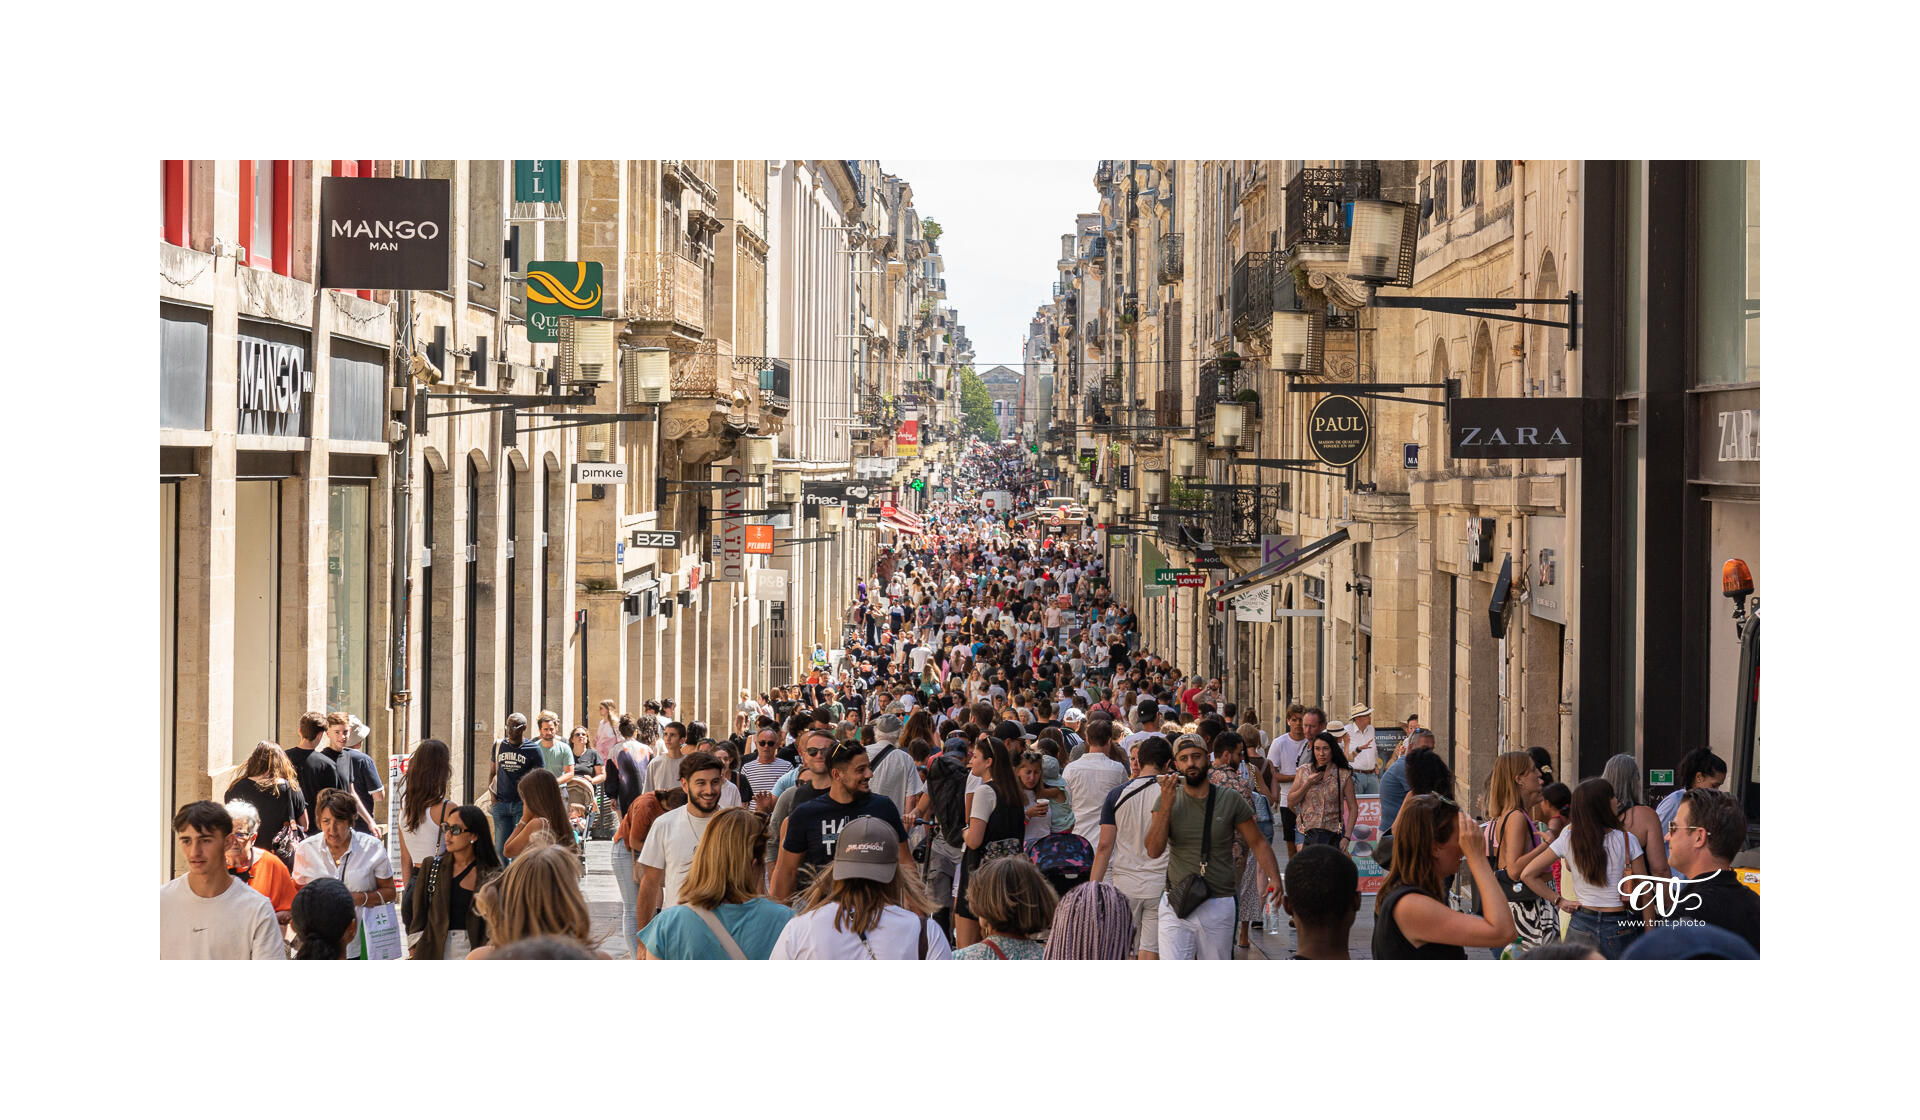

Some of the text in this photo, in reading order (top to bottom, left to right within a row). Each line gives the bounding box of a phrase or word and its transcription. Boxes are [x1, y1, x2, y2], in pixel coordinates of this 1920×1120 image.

[331, 219, 439, 240] MANGO
[369, 242, 398, 251] MAN
[239, 340, 301, 414] MANGO
[1315, 416, 1364, 432] PAUL
[1459, 427, 1572, 447] ZARA
[582, 468, 624, 480] pimkie
[806, 493, 839, 505] fnac
[636, 533, 676, 547] BZB
